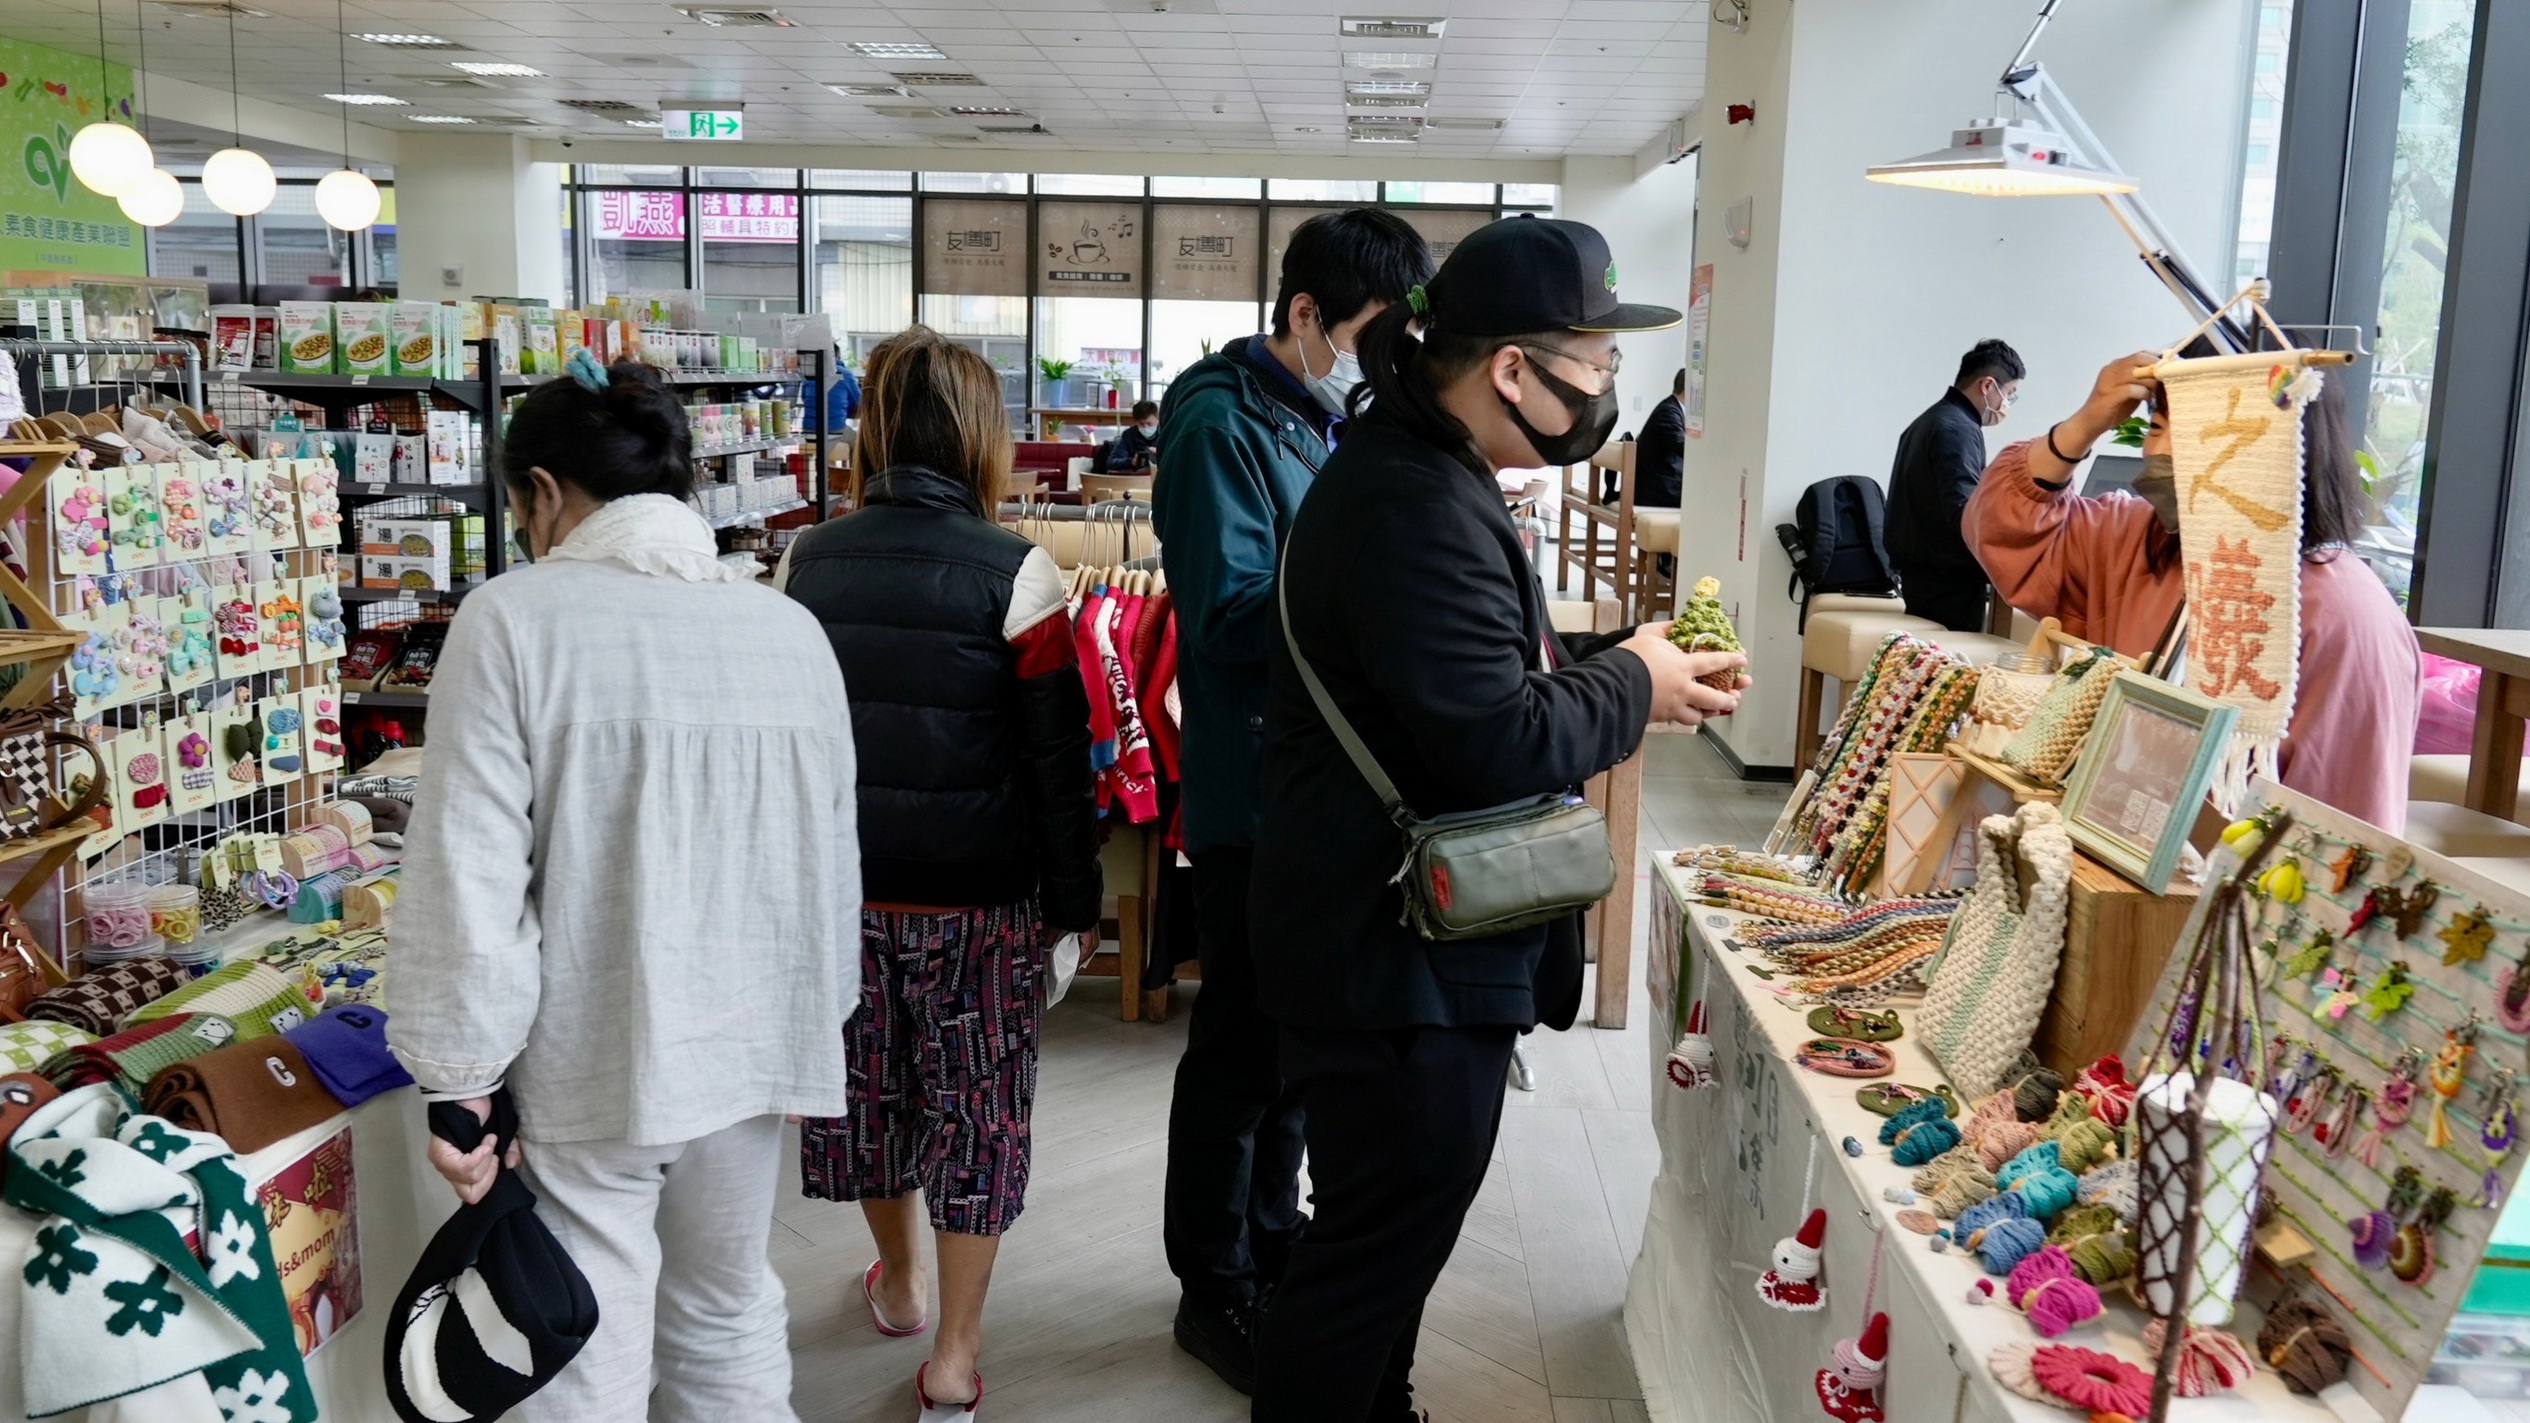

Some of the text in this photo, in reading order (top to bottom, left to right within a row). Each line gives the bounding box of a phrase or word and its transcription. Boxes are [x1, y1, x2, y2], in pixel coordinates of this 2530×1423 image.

[0, 213, 131, 248] 素食健康產業聯盟
[702, 218, 798, 236] 照輔具特約
[266, 1056, 296, 1087] C
